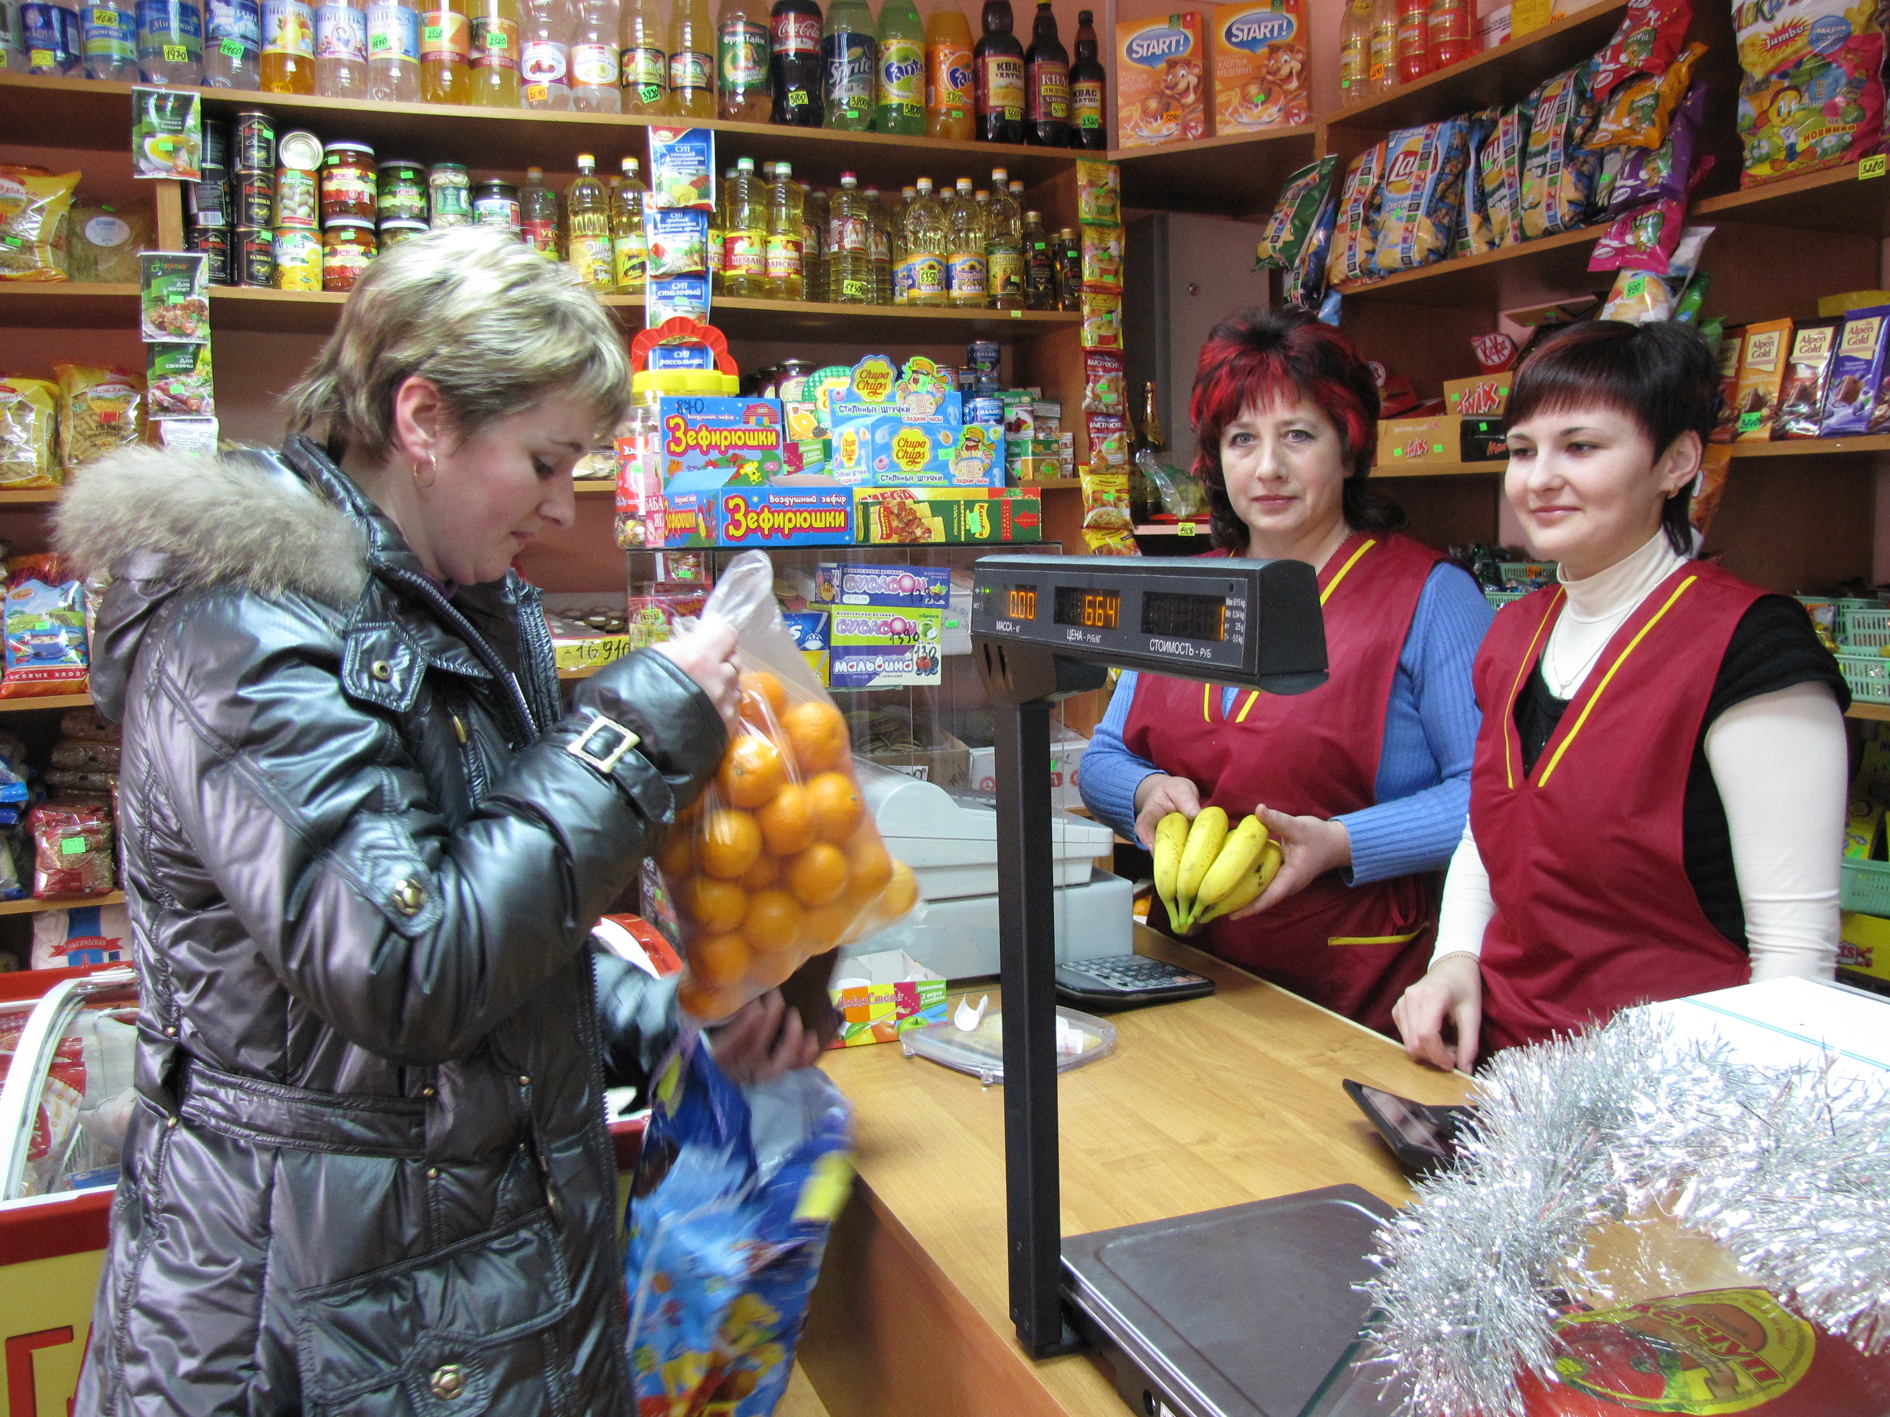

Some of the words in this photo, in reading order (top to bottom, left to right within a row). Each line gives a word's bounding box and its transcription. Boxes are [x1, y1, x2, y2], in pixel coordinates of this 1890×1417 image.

[1231, 19, 1289, 43] START!
[1765, 26, 1805, 50] Jumbo
[1131, 35, 1185, 59] START!
[828, 55, 873, 84] Sprite
[1217, 58, 1248, 69] ХЛОПЬЯ
[884, 57, 924, 85] Fanta
[1216, 66, 1253, 78] МЕДОВЫЕ
[1119, 74, 1148, 85] ХЛОПЬЯ
[1072, 88, 1098, 98] КВАС
[1119, 81, 1153, 93] МЕДОВЫЕ
[1803, 124, 1856, 143] новинка
[674, 145, 691, 153] СУП
[671, 282, 688, 290] СУП
[657, 288, 702, 297] столовый
[1848, 324, 1875, 337] Alpen
[1752, 339, 1775, 350] Alpen
[1799, 333, 1826, 345] Alpen
[1847, 336, 1870, 346] Gold
[673, 350, 690, 359] СУП
[1751, 350, 1771, 360] Gold
[1799, 344, 1823, 354] Gold
[659, 357, 705, 366] рассольник
[859, 369, 890, 380] Chupa
[856, 380, 888, 392] Chups
[676, 398, 705, 416] 870
[1089, 421, 1123, 430] БЫСТРОСУП
[173, 434, 201, 444] Перец
[668, 416, 777, 454] Зефирюшки
[897, 438, 927, 451] Chupa
[895, 449, 925, 461] Chups
[769, 494, 818, 507] воздушный
[821, 495, 848, 506] зефир
[727, 497, 846, 538] Зефирюшки
[995, 619, 1014, 632] МАССА
[1066, 628, 1084, 642] ЦЕНА
[1148, 638, 1195, 656] СТОИМОСТЬ
[1199, 647, 1212, 658] РУБ
[834, 655, 913, 674] мальвина
[63, 938, 107, 950] КЛАССИЧЕСКАЯ
[916, 983, 946, 992] Новинка!
